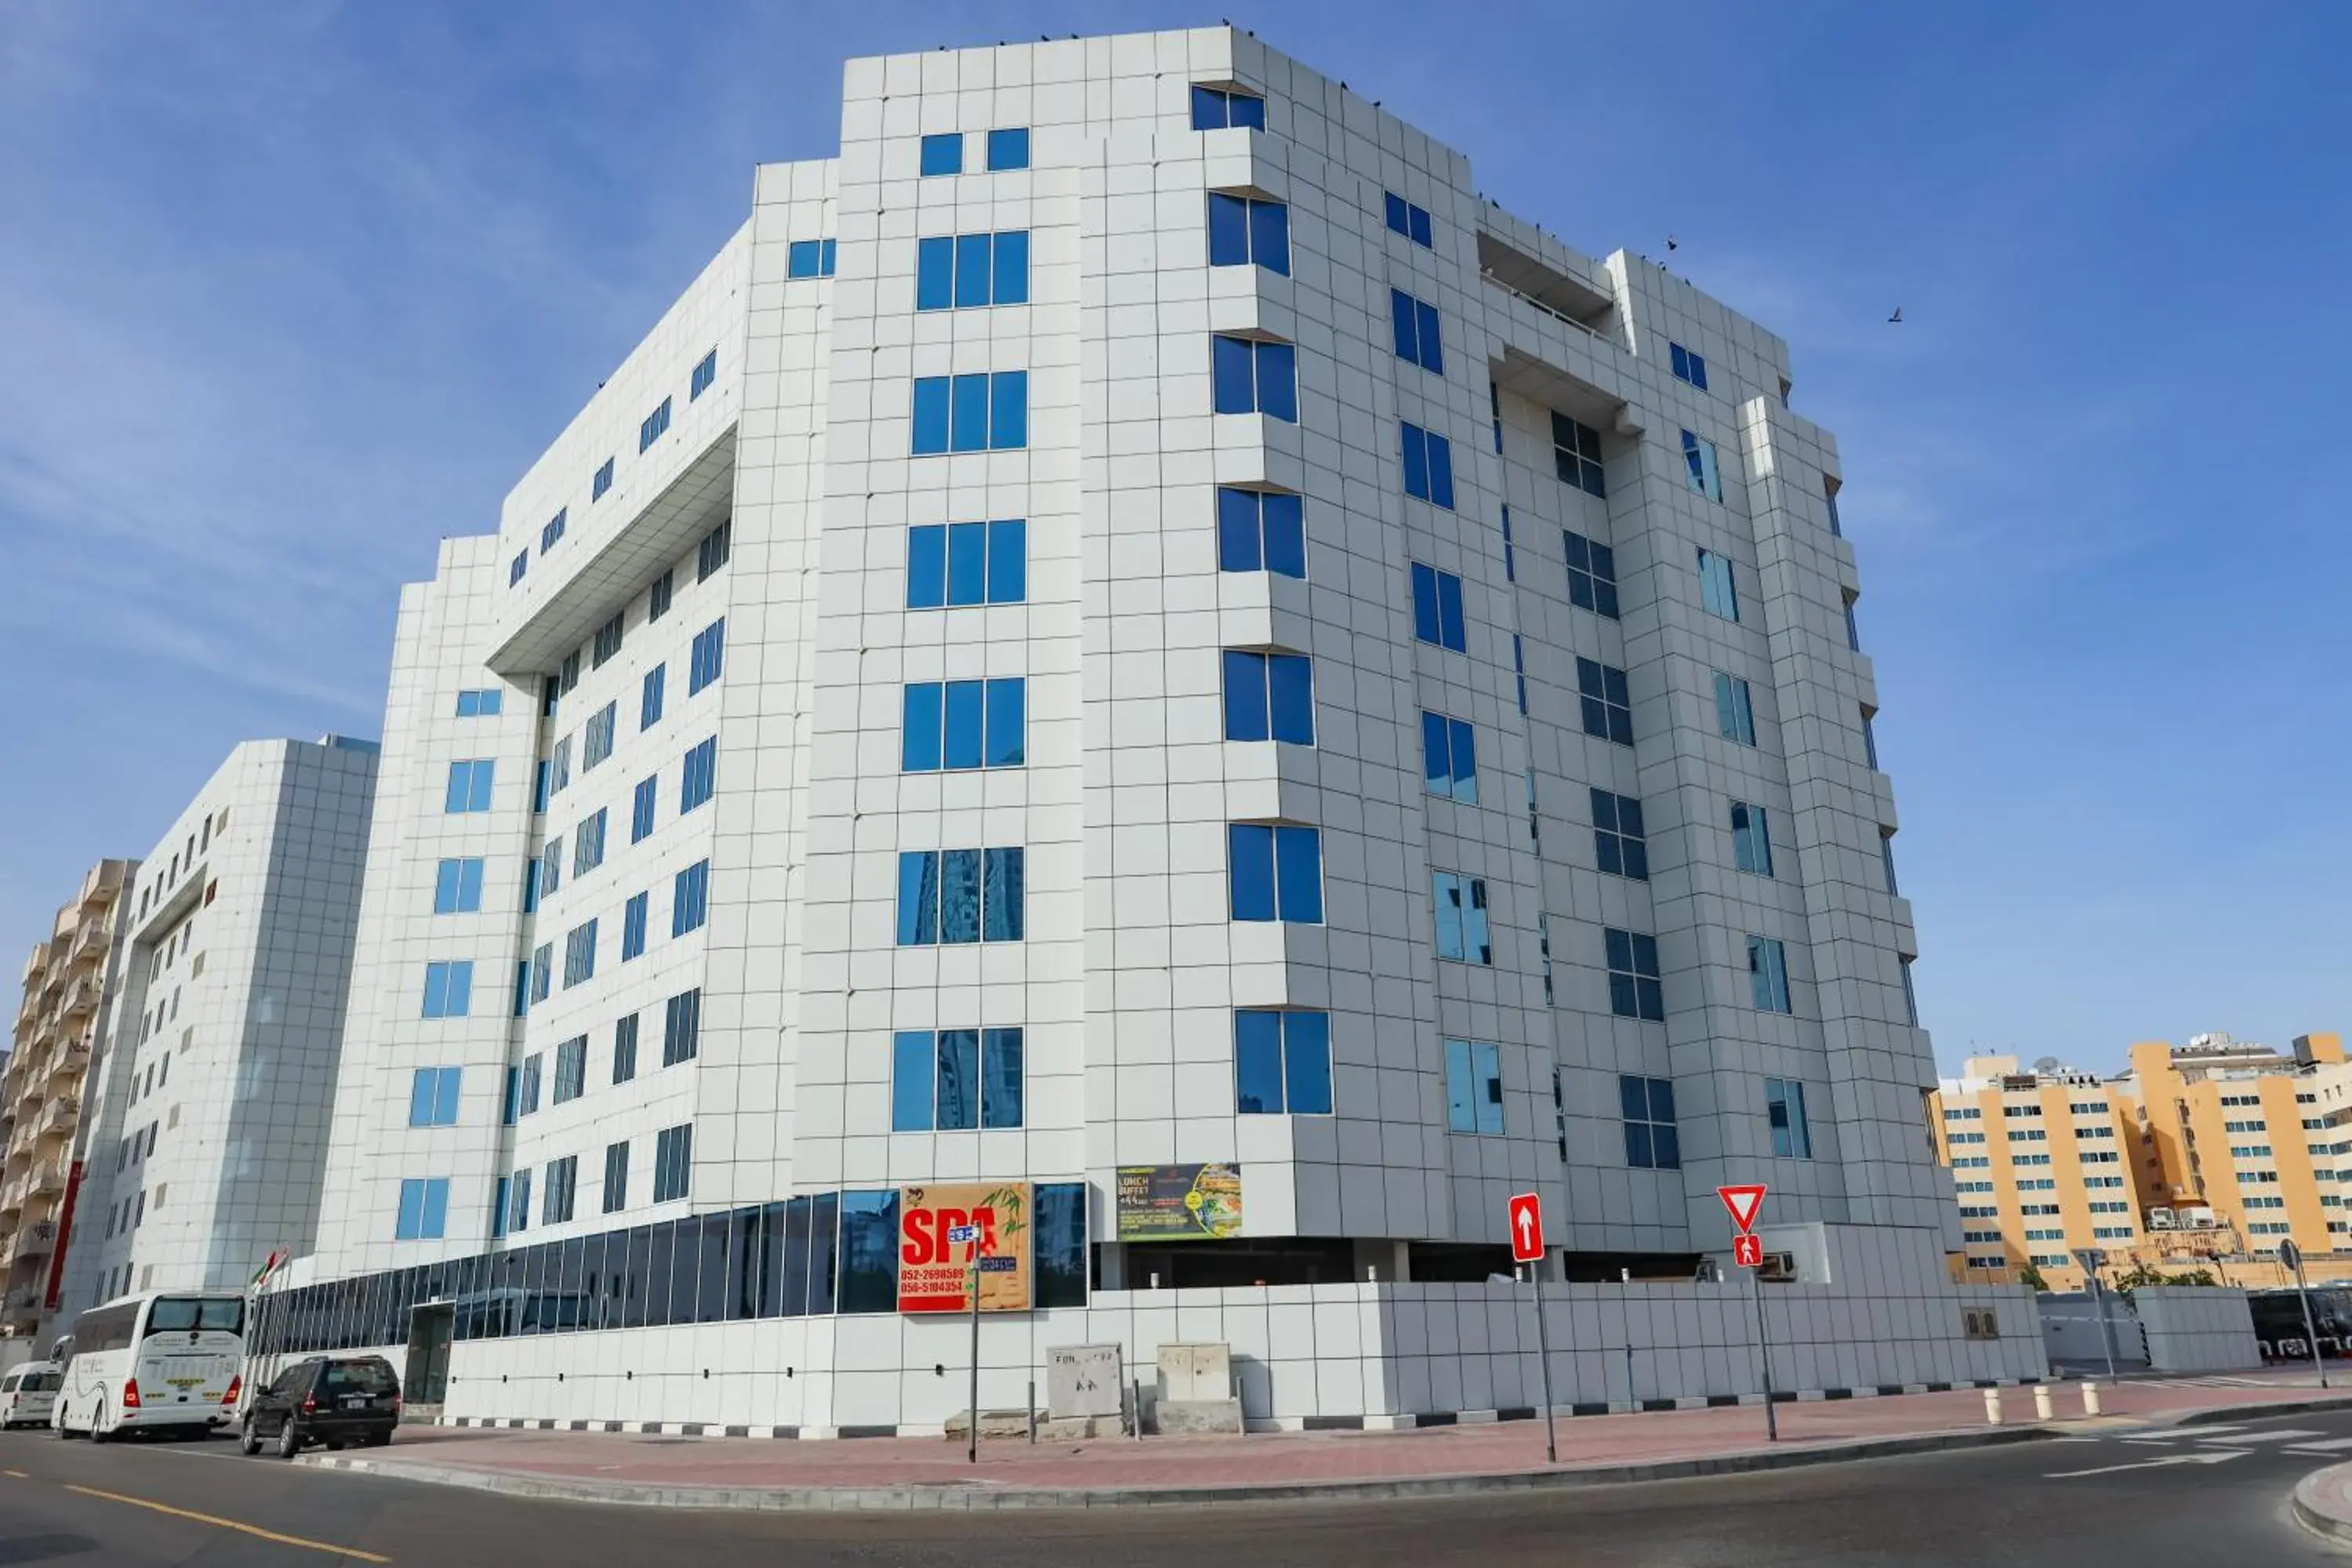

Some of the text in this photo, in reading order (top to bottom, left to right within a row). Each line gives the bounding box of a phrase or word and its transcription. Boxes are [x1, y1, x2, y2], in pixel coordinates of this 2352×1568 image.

[1118, 1176, 1149, 1186] LUNCH
[1118, 1186, 1149, 1196] BUFFET
[902, 1207, 996, 1265] SPA
